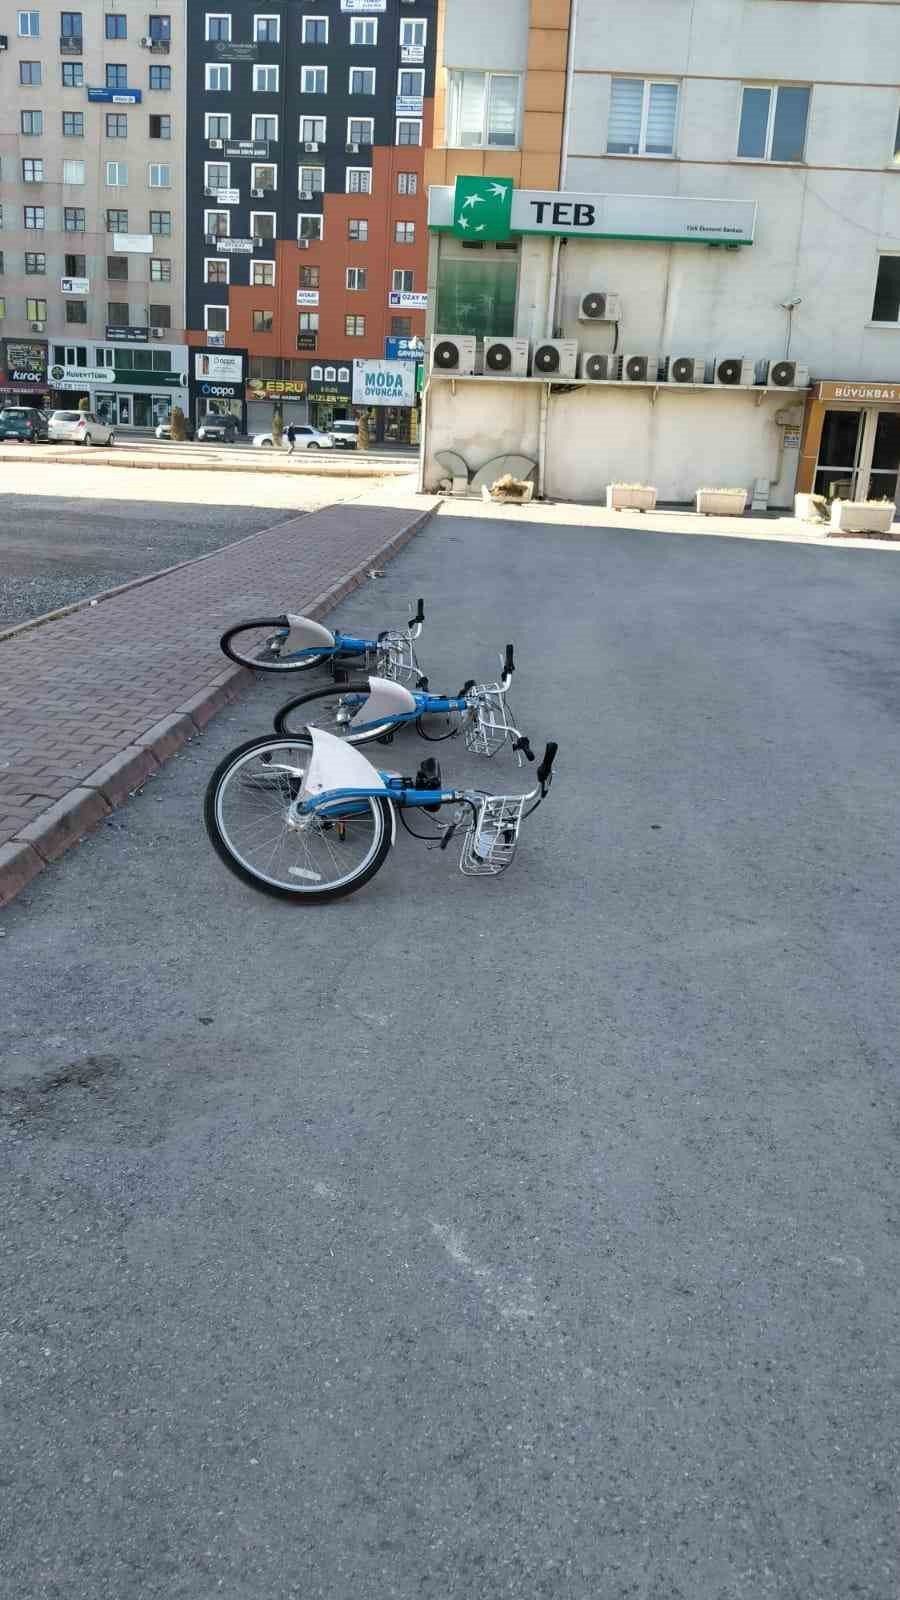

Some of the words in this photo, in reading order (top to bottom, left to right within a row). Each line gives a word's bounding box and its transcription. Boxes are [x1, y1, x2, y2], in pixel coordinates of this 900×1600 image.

[530, 201, 595, 226] TEB
[266, 382, 304, 393] EBRU
[364, 372, 404, 388] MODA
